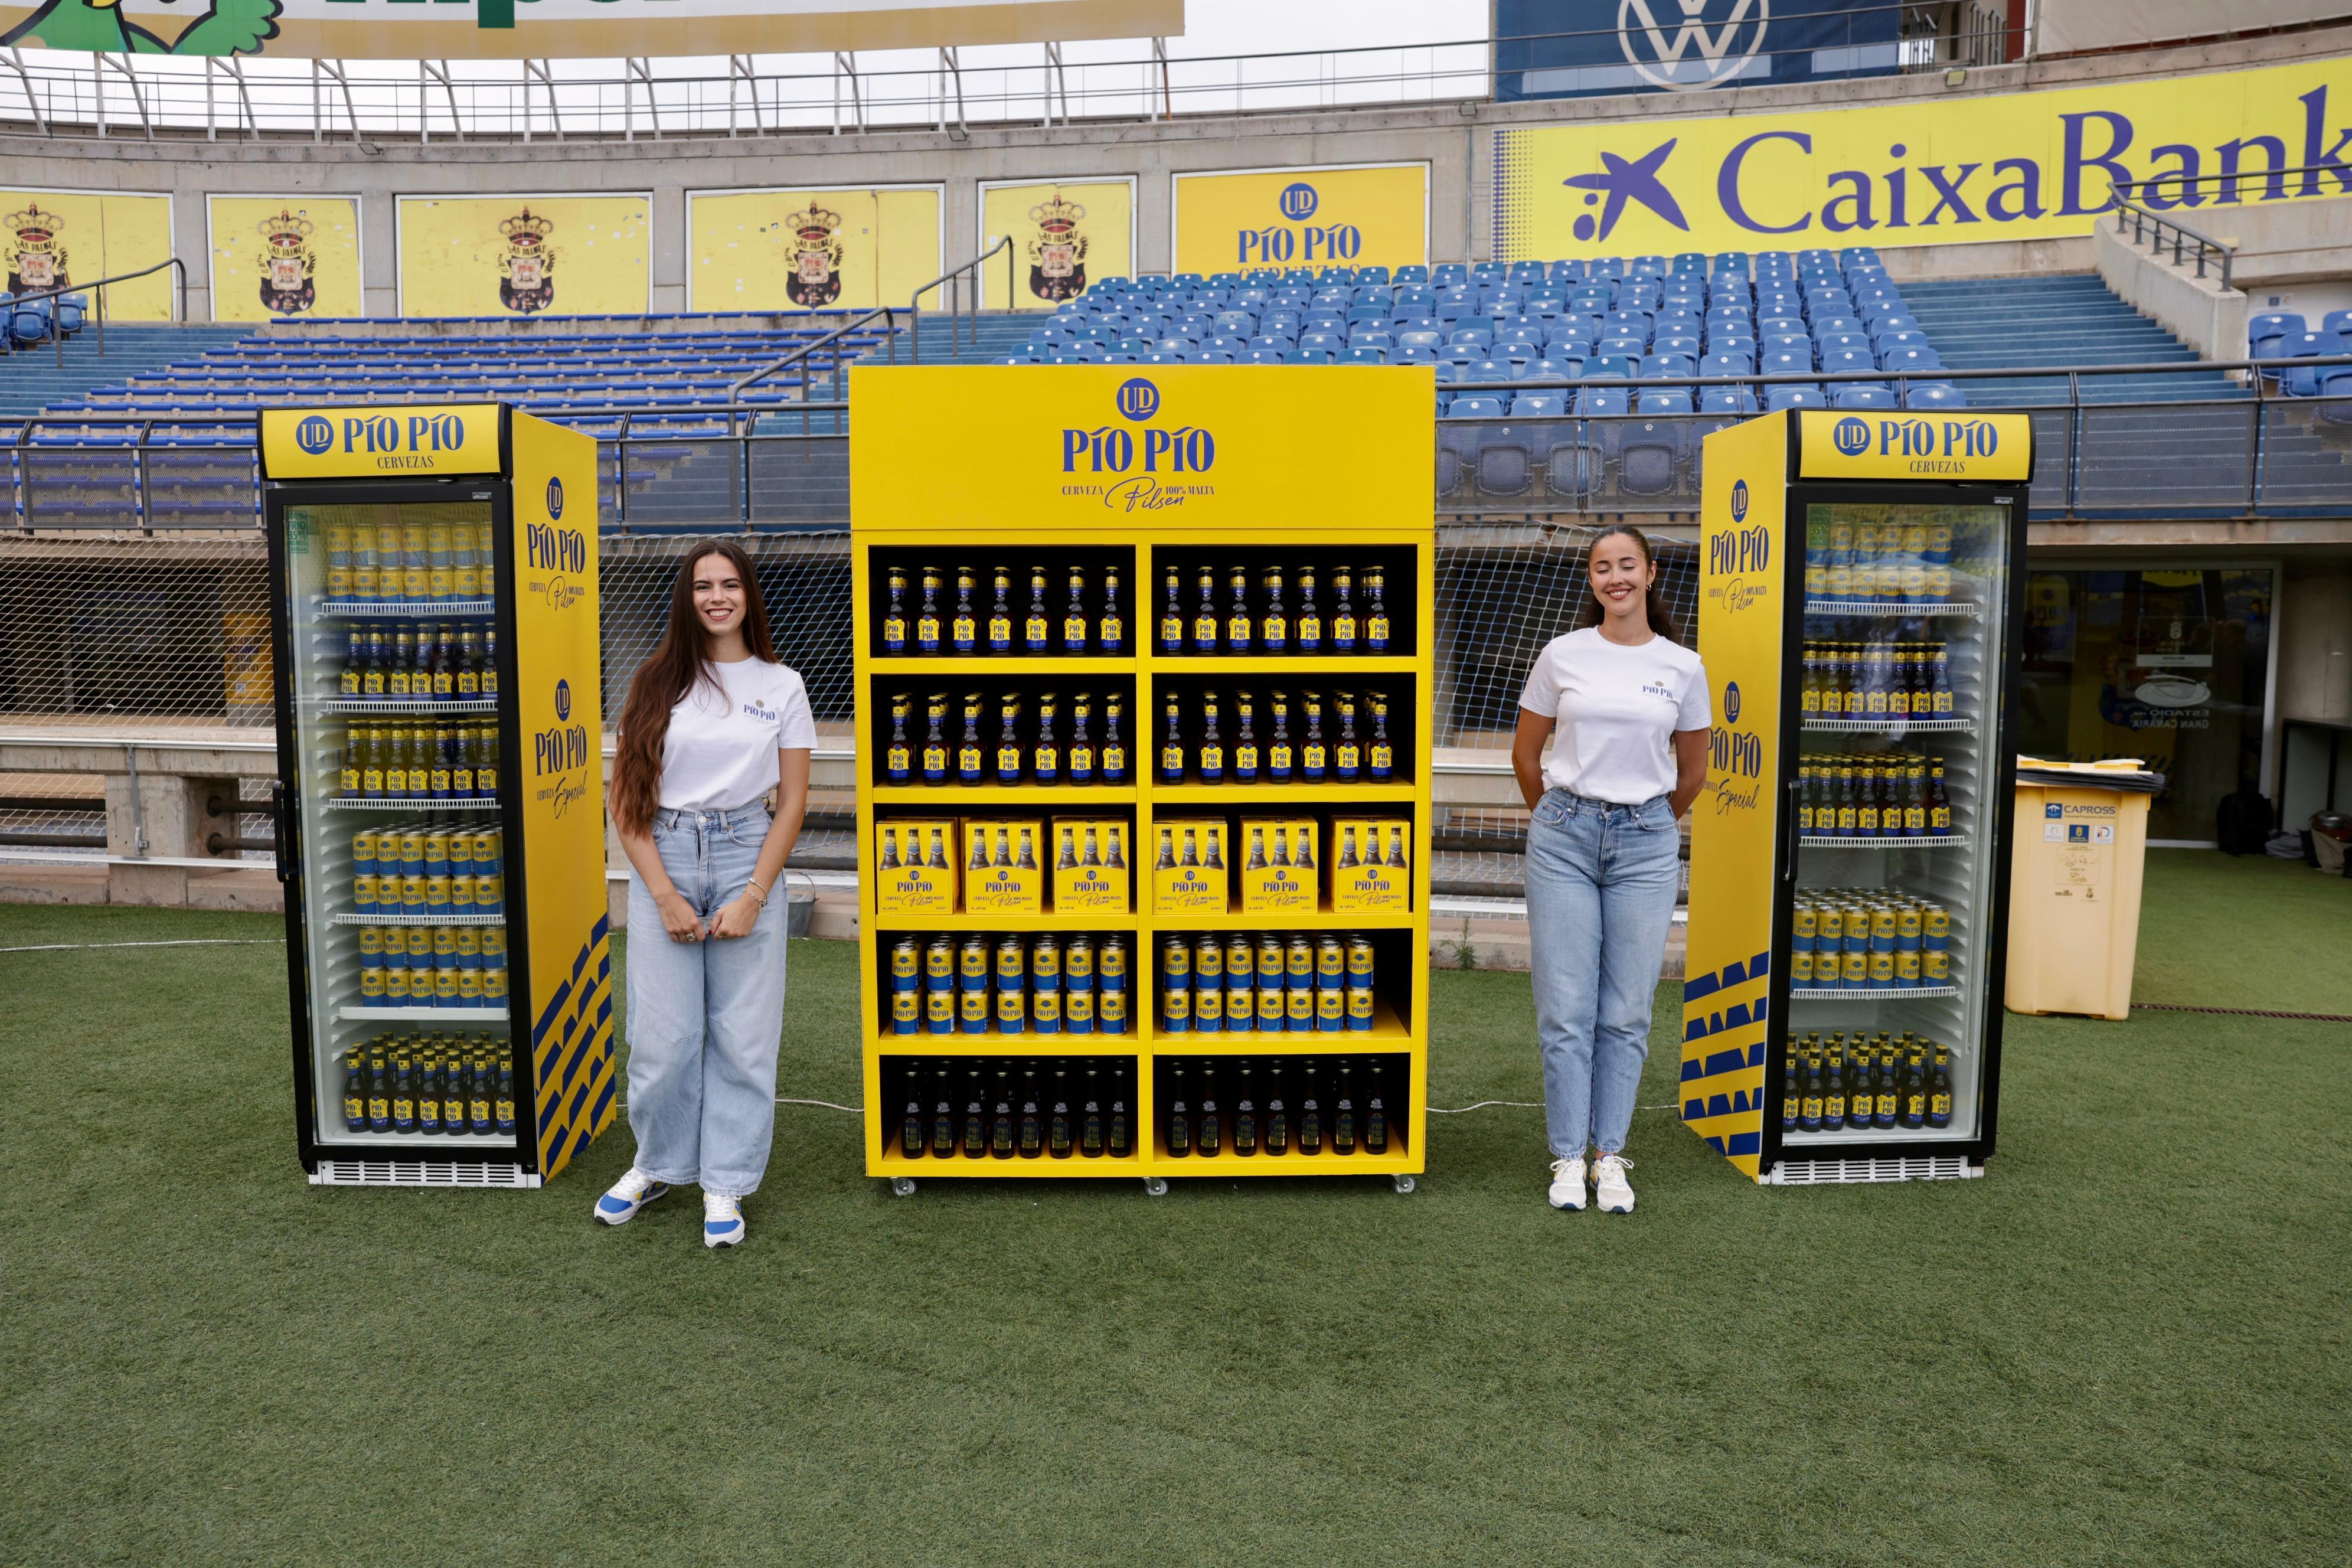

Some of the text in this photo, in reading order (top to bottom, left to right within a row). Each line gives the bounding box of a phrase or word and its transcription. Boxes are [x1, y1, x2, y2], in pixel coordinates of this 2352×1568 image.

[1717, 84, 2352, 234] CaixaBank
[377, 455, 434, 469] CERVEZAS
[1910, 460, 1965, 473] CERVEZAS
[1062, 476, 1214, 512] CERVEZA Pilsen 100% MALTA
[529, 582, 546, 593] CERVEZA
[547, 576, 575, 610] Pilsen
[1709, 588, 1723, 597] CERVEZA
[1723, 578, 1753, 613] Pilsen
[537, 770, 587, 819] CERVEZA Especial
[1704, 778, 1760, 816] ERVEZA Especial
[2064, 805, 2116, 815] CAPROSS
[902, 893, 933, 907] Pilsen
[990, 893, 1020, 907] Pilsen
[1079, 893, 1109, 906] Pilsen
[1177, 893, 1207, 907] Pilsen
[1268, 893, 1298, 906] Pilsen
[1359, 892, 1390, 906] Pilsen
